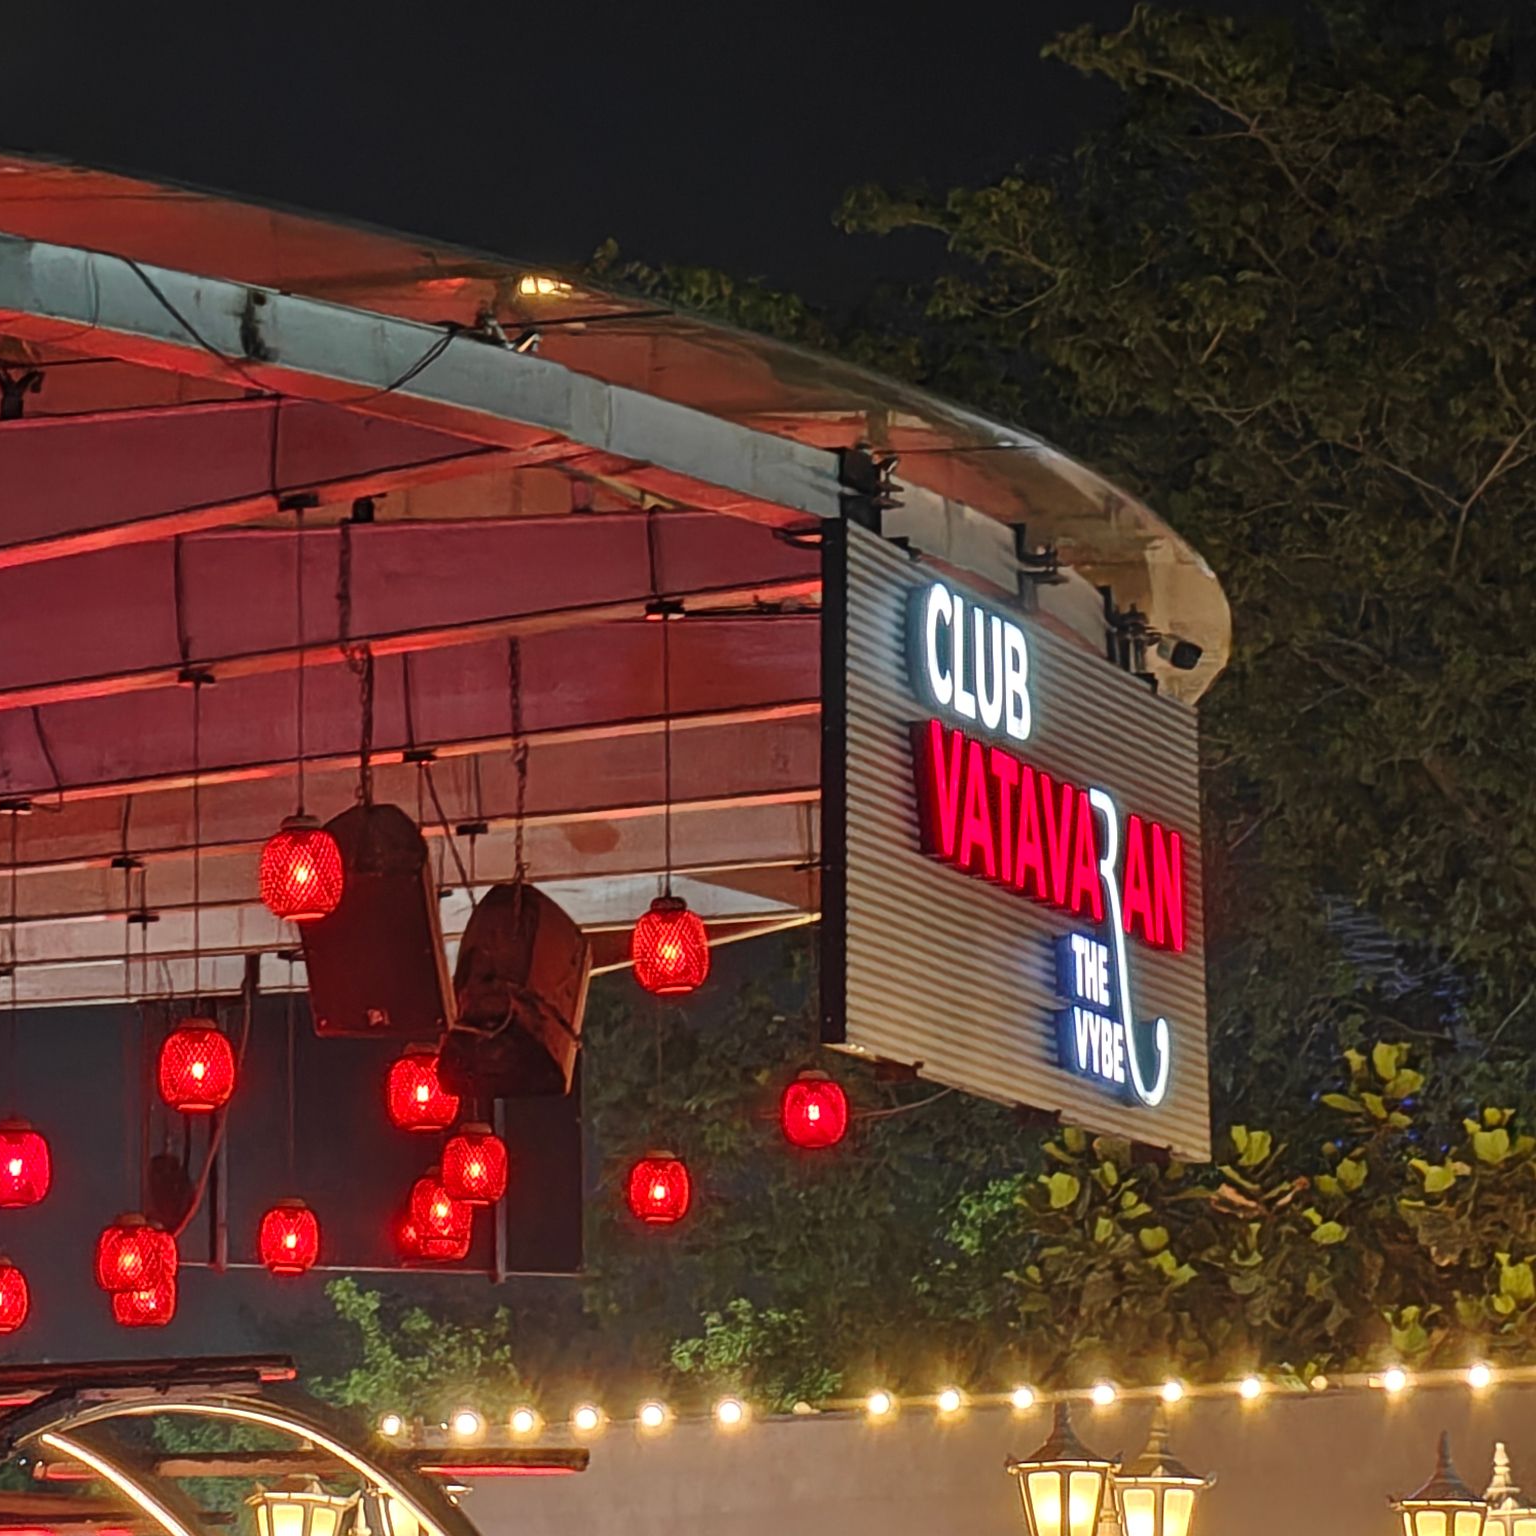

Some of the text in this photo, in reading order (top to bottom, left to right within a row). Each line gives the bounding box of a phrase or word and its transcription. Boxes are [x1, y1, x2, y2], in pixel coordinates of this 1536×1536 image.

[925, 582, 1033, 742] CLUB
[928, 717, 1185, 1108] VATAVARAN
[1071, 933, 1110, 1008] THE
[1073, 1005, 1126, 1084] VYBE
